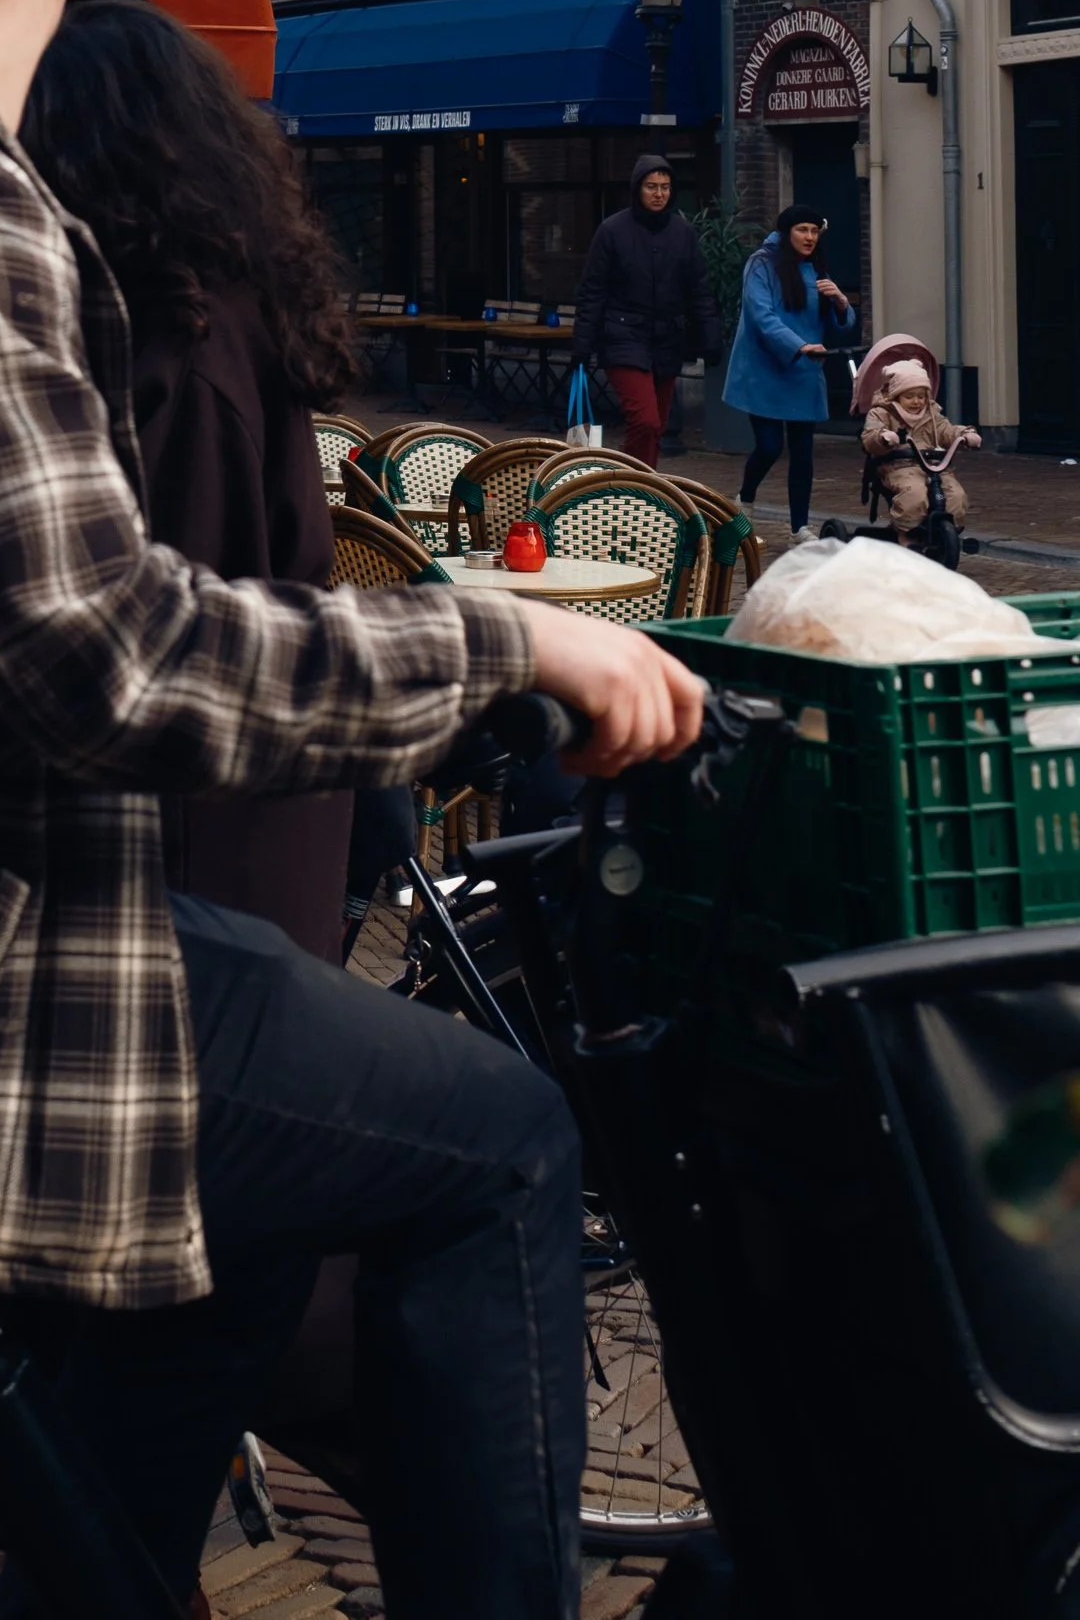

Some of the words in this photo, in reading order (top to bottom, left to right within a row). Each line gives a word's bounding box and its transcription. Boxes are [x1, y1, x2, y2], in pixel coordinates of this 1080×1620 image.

[776, 69, 813, 86] DONKERE
[814, 67, 845, 83] GAARD
[768, 89, 808, 111] GÉRARD
[440, 111, 471, 128] VERHALEN
